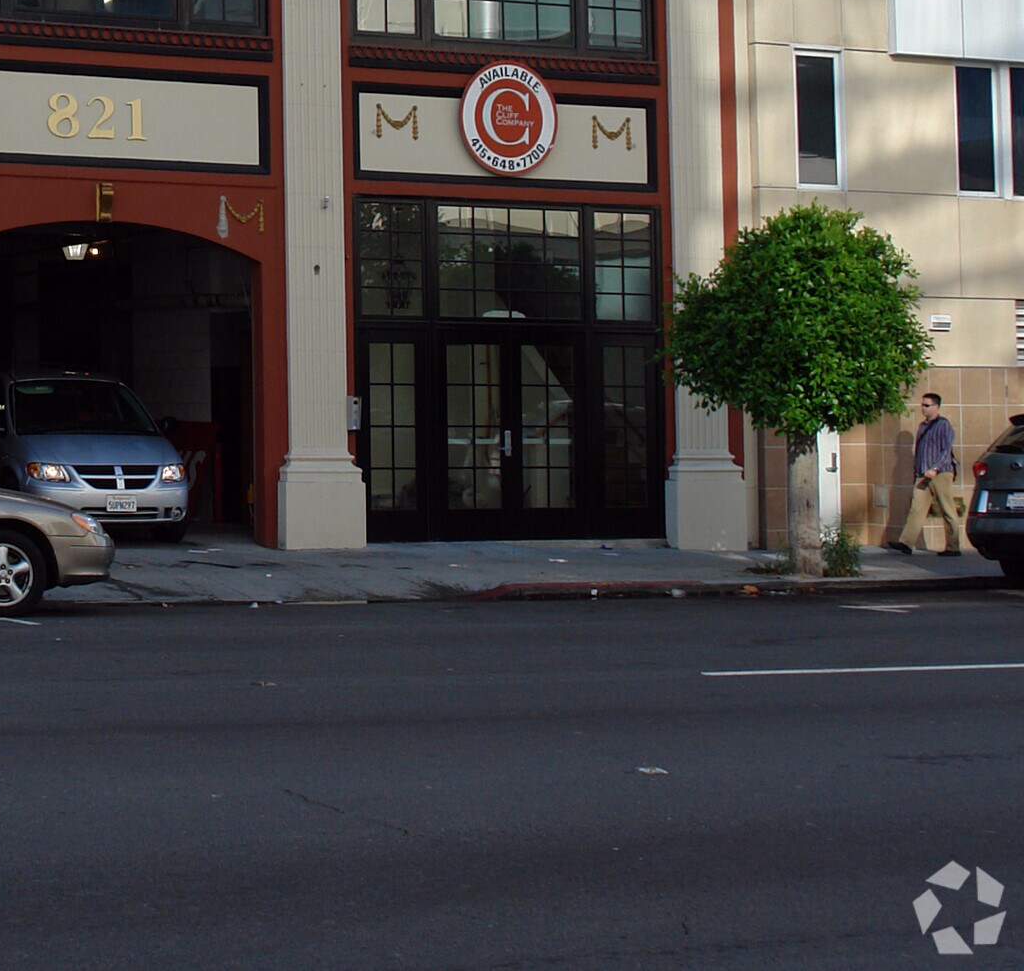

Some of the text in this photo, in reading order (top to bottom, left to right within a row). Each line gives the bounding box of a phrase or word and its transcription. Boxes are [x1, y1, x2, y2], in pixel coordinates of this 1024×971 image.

[479, 66, 541, 94] AVAILABLE
[47, 92, 148, 141] 821
[496, 103, 513, 112] THE
[496, 111, 520, 119] CLIFF
[481, 88, 530, 146] C
[496, 118, 535, 127] COMPANY
